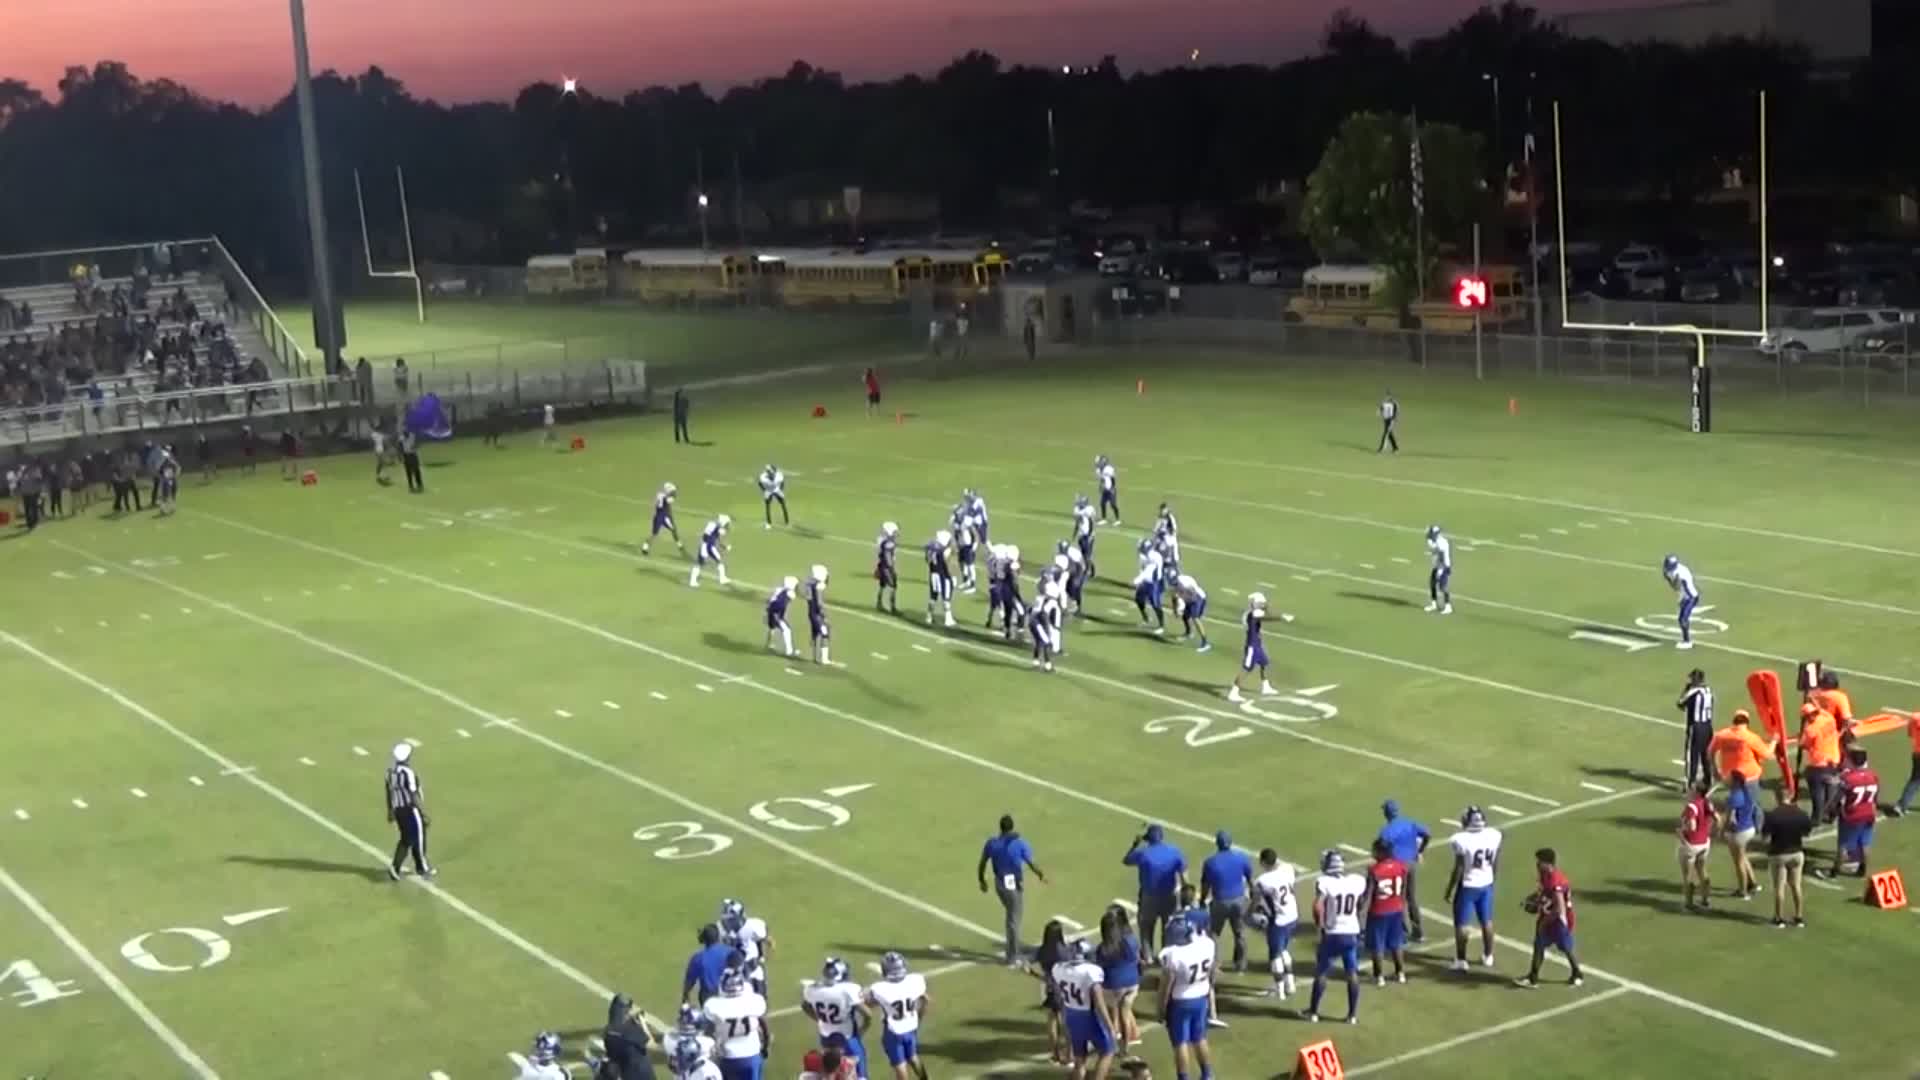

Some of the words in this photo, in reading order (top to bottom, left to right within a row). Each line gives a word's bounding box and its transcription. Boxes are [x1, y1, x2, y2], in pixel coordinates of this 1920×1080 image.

[1458, 279, 1486, 307] 24
[1806, 662, 1817, 688] 1
[1143, 696, 1338, 747] 20
[1852, 783, 1879, 806] 77
[633, 797, 851, 860] 30
[1472, 848, 1494, 868] 64
[1378, 875, 1402, 899] 51
[1877, 874, 1902, 904] 20
[1335, 893, 1356, 915] 10
[1188, 958, 1212, 985] 75
[890, 997, 918, 1021] 34
[725, 1015, 751, 1038] 71
[1307, 1046, 1338, 1080] 30
